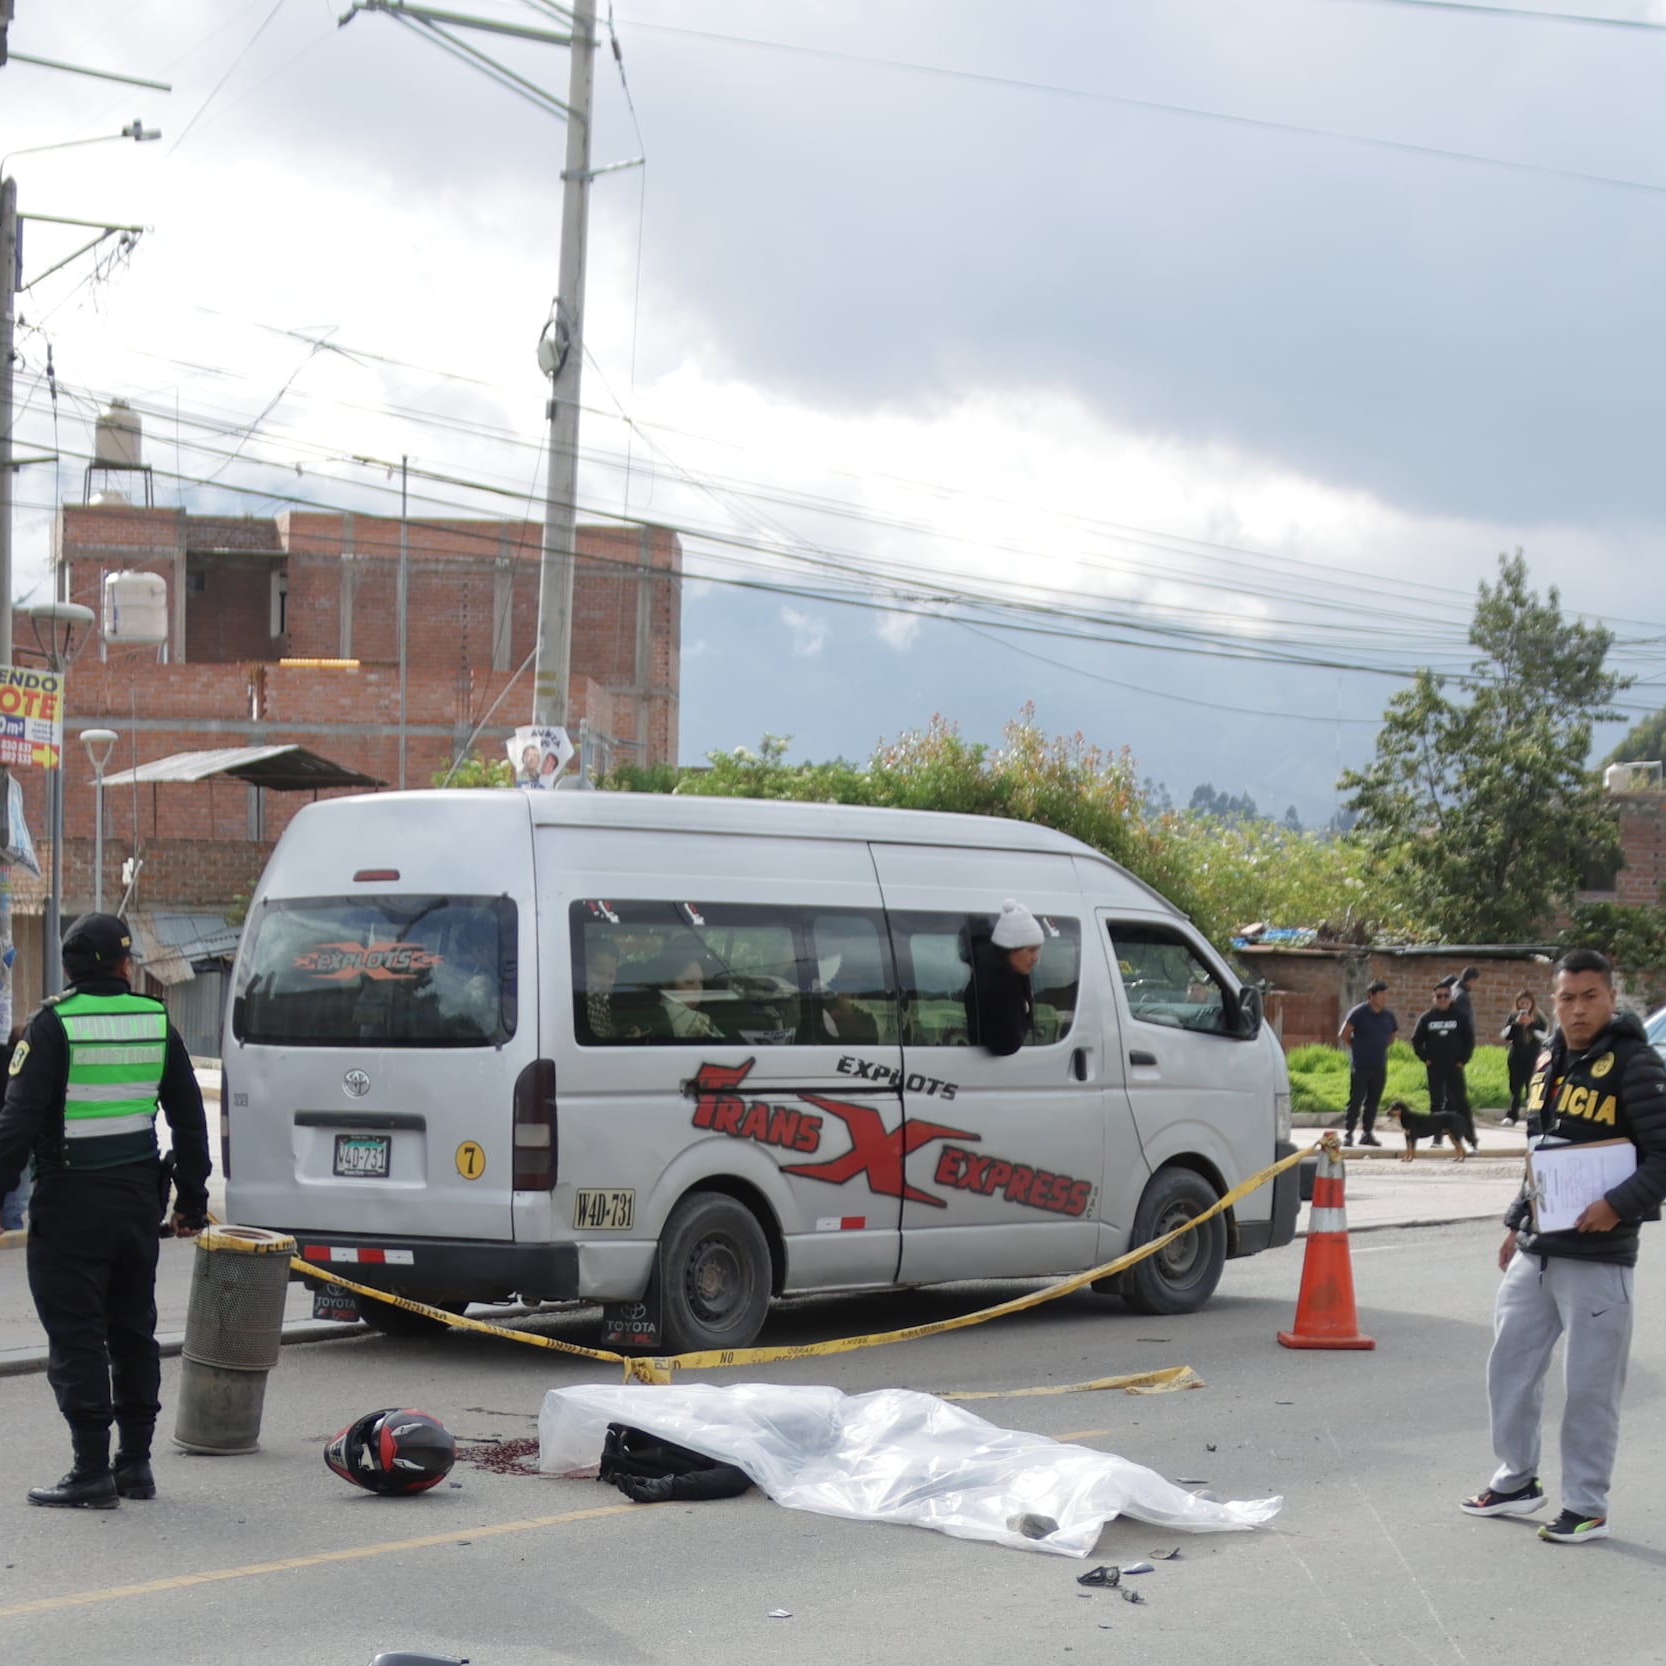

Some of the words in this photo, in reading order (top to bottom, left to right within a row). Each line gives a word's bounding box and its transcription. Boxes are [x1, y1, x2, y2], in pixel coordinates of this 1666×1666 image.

[316, 948, 415, 971] EXPLOTS
[836, 1055, 959, 1101] EXPLOTS
[691, 1056, 824, 1153] TRANS
[464, 1147, 476, 1175] 7
[935, 1145, 1093, 1218] EXPRESS
[577, 1193, 633, 1227] W4D-731
[315, 1296, 356, 1310] TOYOTA
[606, 1320, 657, 1333] TOYOTA
[720, 1351, 734, 1364] NO
